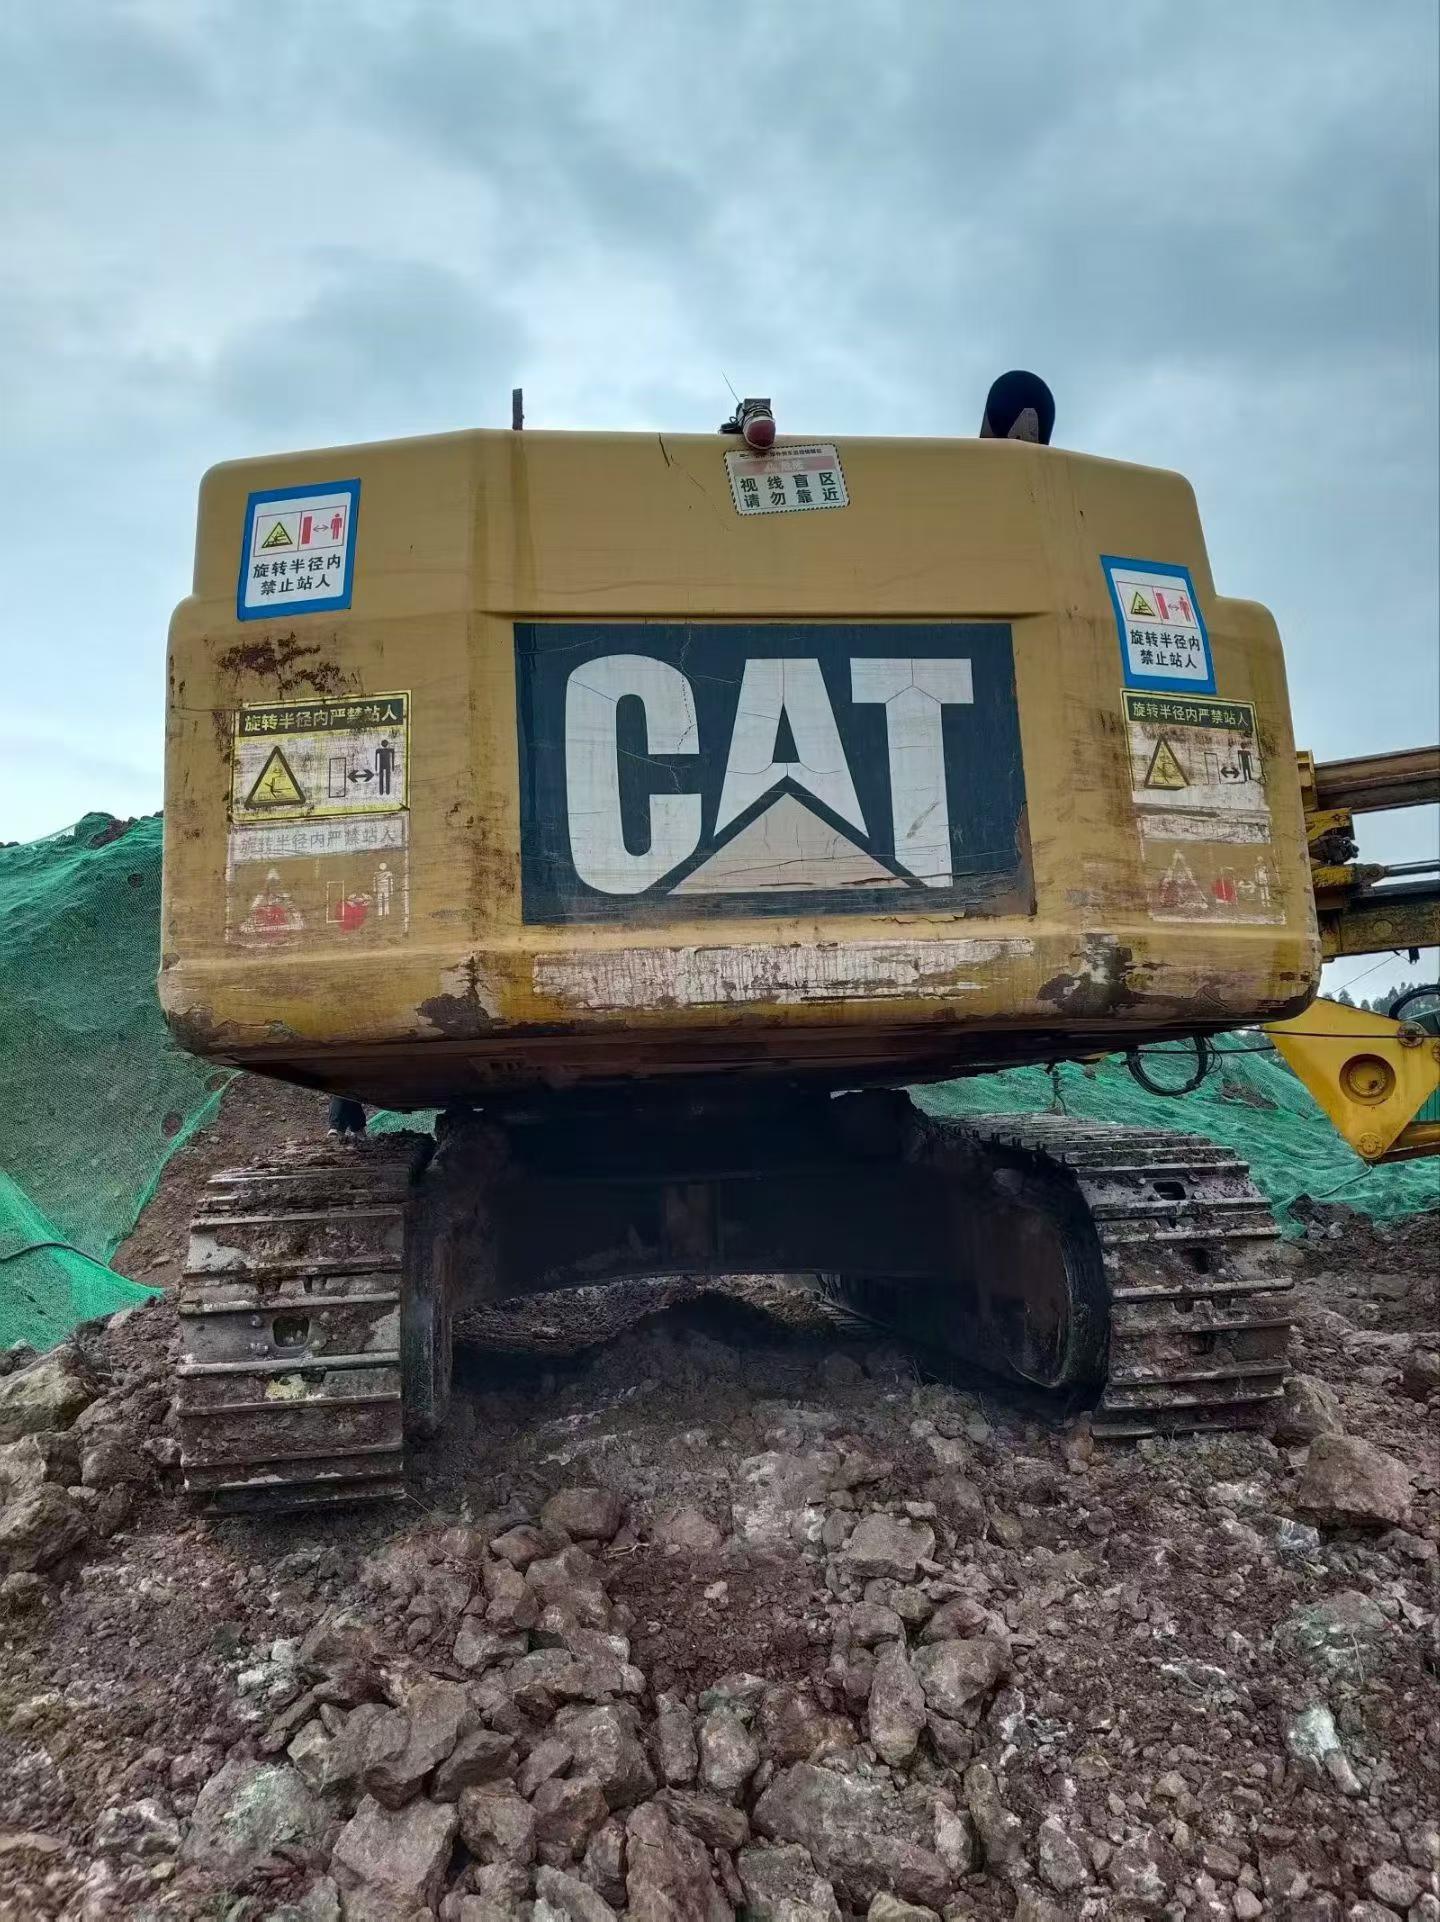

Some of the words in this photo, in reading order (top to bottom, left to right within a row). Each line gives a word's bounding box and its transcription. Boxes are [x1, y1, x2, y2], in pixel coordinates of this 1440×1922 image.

[740, 471, 836, 492] 视线盲区
[744, 488, 840, 508] 请勿靠近
[253, 553, 341, 579] 旋转半径内
[260, 573, 331, 596] 禁止站人
[1130, 629, 1201, 651] 旋转半径内
[1140, 649, 1197, 669] 禁止站人
[244, 704, 398, 732] 旋转半径内严禁站人
[1132, 702, 1248, 728] 旋转半径内严禁站人
[565, 654, 974, 895] CAT
